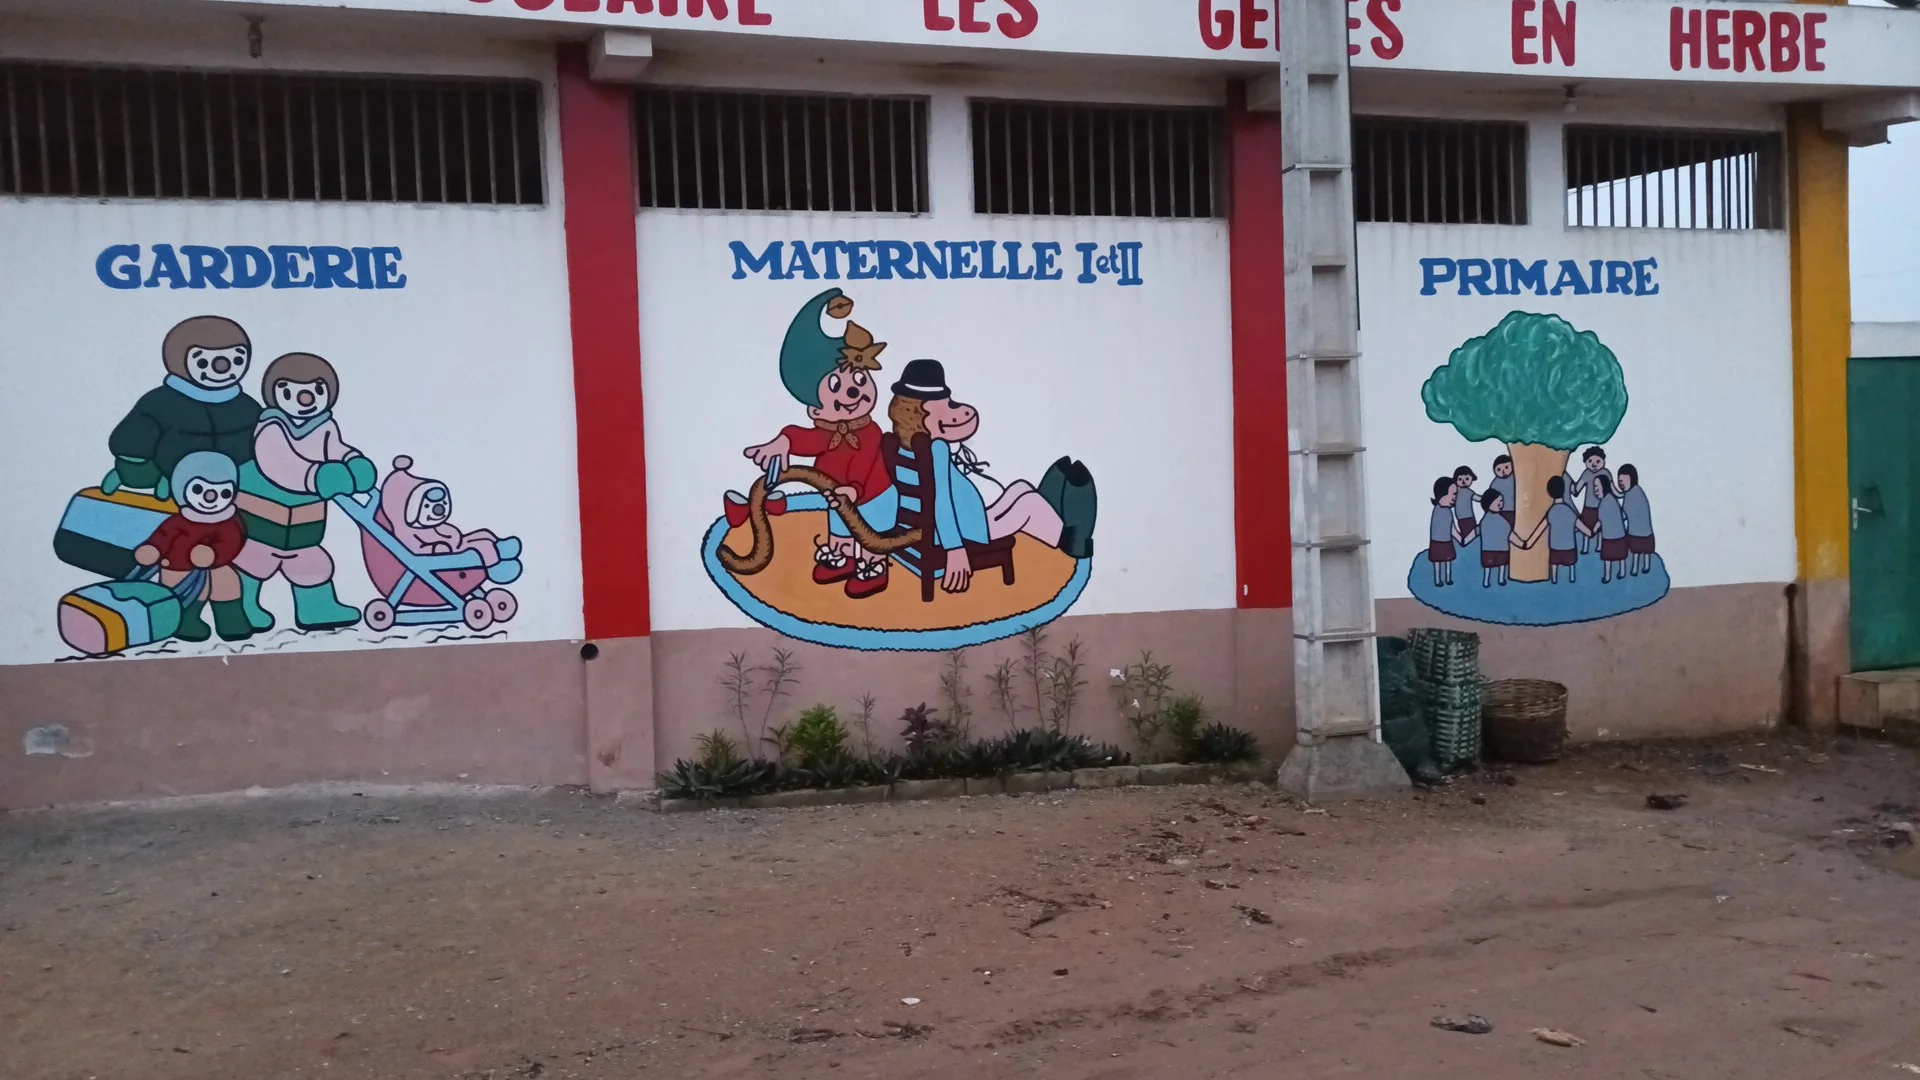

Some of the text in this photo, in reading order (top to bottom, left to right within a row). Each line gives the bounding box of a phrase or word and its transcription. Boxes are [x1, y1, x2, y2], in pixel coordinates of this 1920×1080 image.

[1511, 0, 1576, 67] EN
[1669, 6, 1828, 73] HERBE
[95, 243, 407, 290] GARDERIE
[728, 240, 1063, 281] MATERNELLE
[1419, 256, 1660, 297] PRIMAIRE
